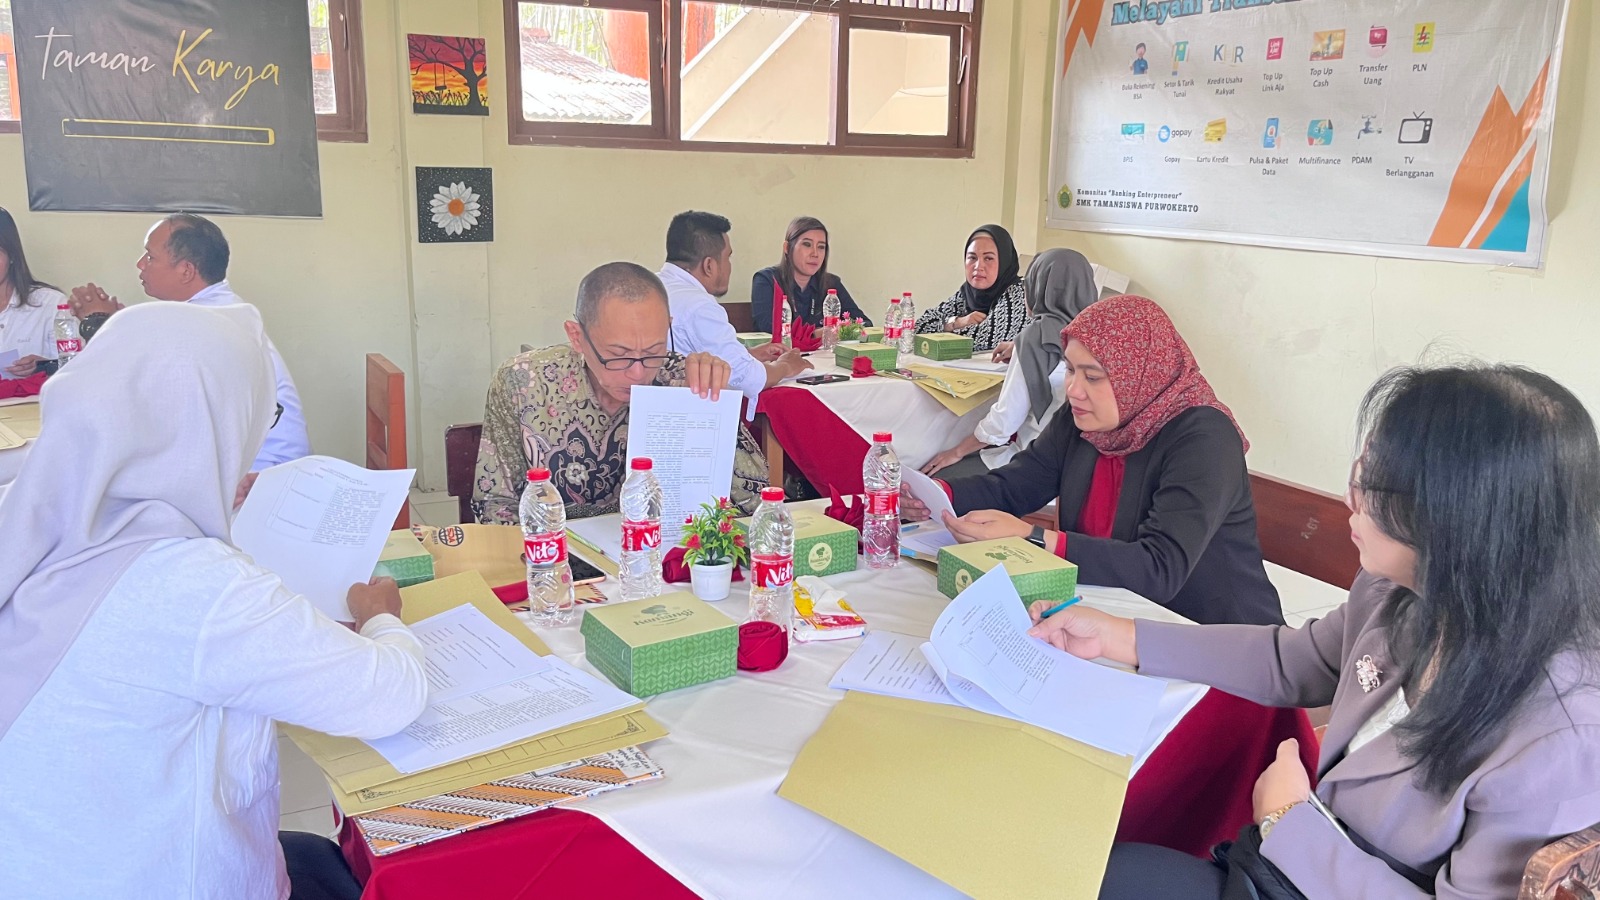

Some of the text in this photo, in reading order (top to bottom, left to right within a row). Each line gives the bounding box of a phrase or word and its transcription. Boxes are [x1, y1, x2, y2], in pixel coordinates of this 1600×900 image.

[1111, 0, 1203, 25] Melayani
[35, 26, 280, 110] Taman Karya
[1310, 67, 1333, 77] Top Up
[1359, 63, 1388, 73] Transfer
[1412, 63, 1427, 72] PLN
[1207, 76, 1243, 85] Kredit Usaha
[1263, 72, 1283, 82] Top Up
[1363, 77, 1382, 86] Uang
[1181, 79, 1194, 87] Tarik
[1313, 79, 1329, 88] Cash
[1215, 87, 1235, 96] Rakyat
[1262, 84, 1284, 93] Link Aja
[1171, 127, 1192, 138] gopay
[1164, 156, 1181, 164] Gopay
[1271, 157, 1289, 165] Paket
[1298, 157, 1341, 165] Multifinance
[1351, 156, 1373, 164] PDAM
[1385, 169, 1434, 178] Berlangganan
[1076, 198, 1199, 213] SMK TAMANSISWA PURWOKERTO
